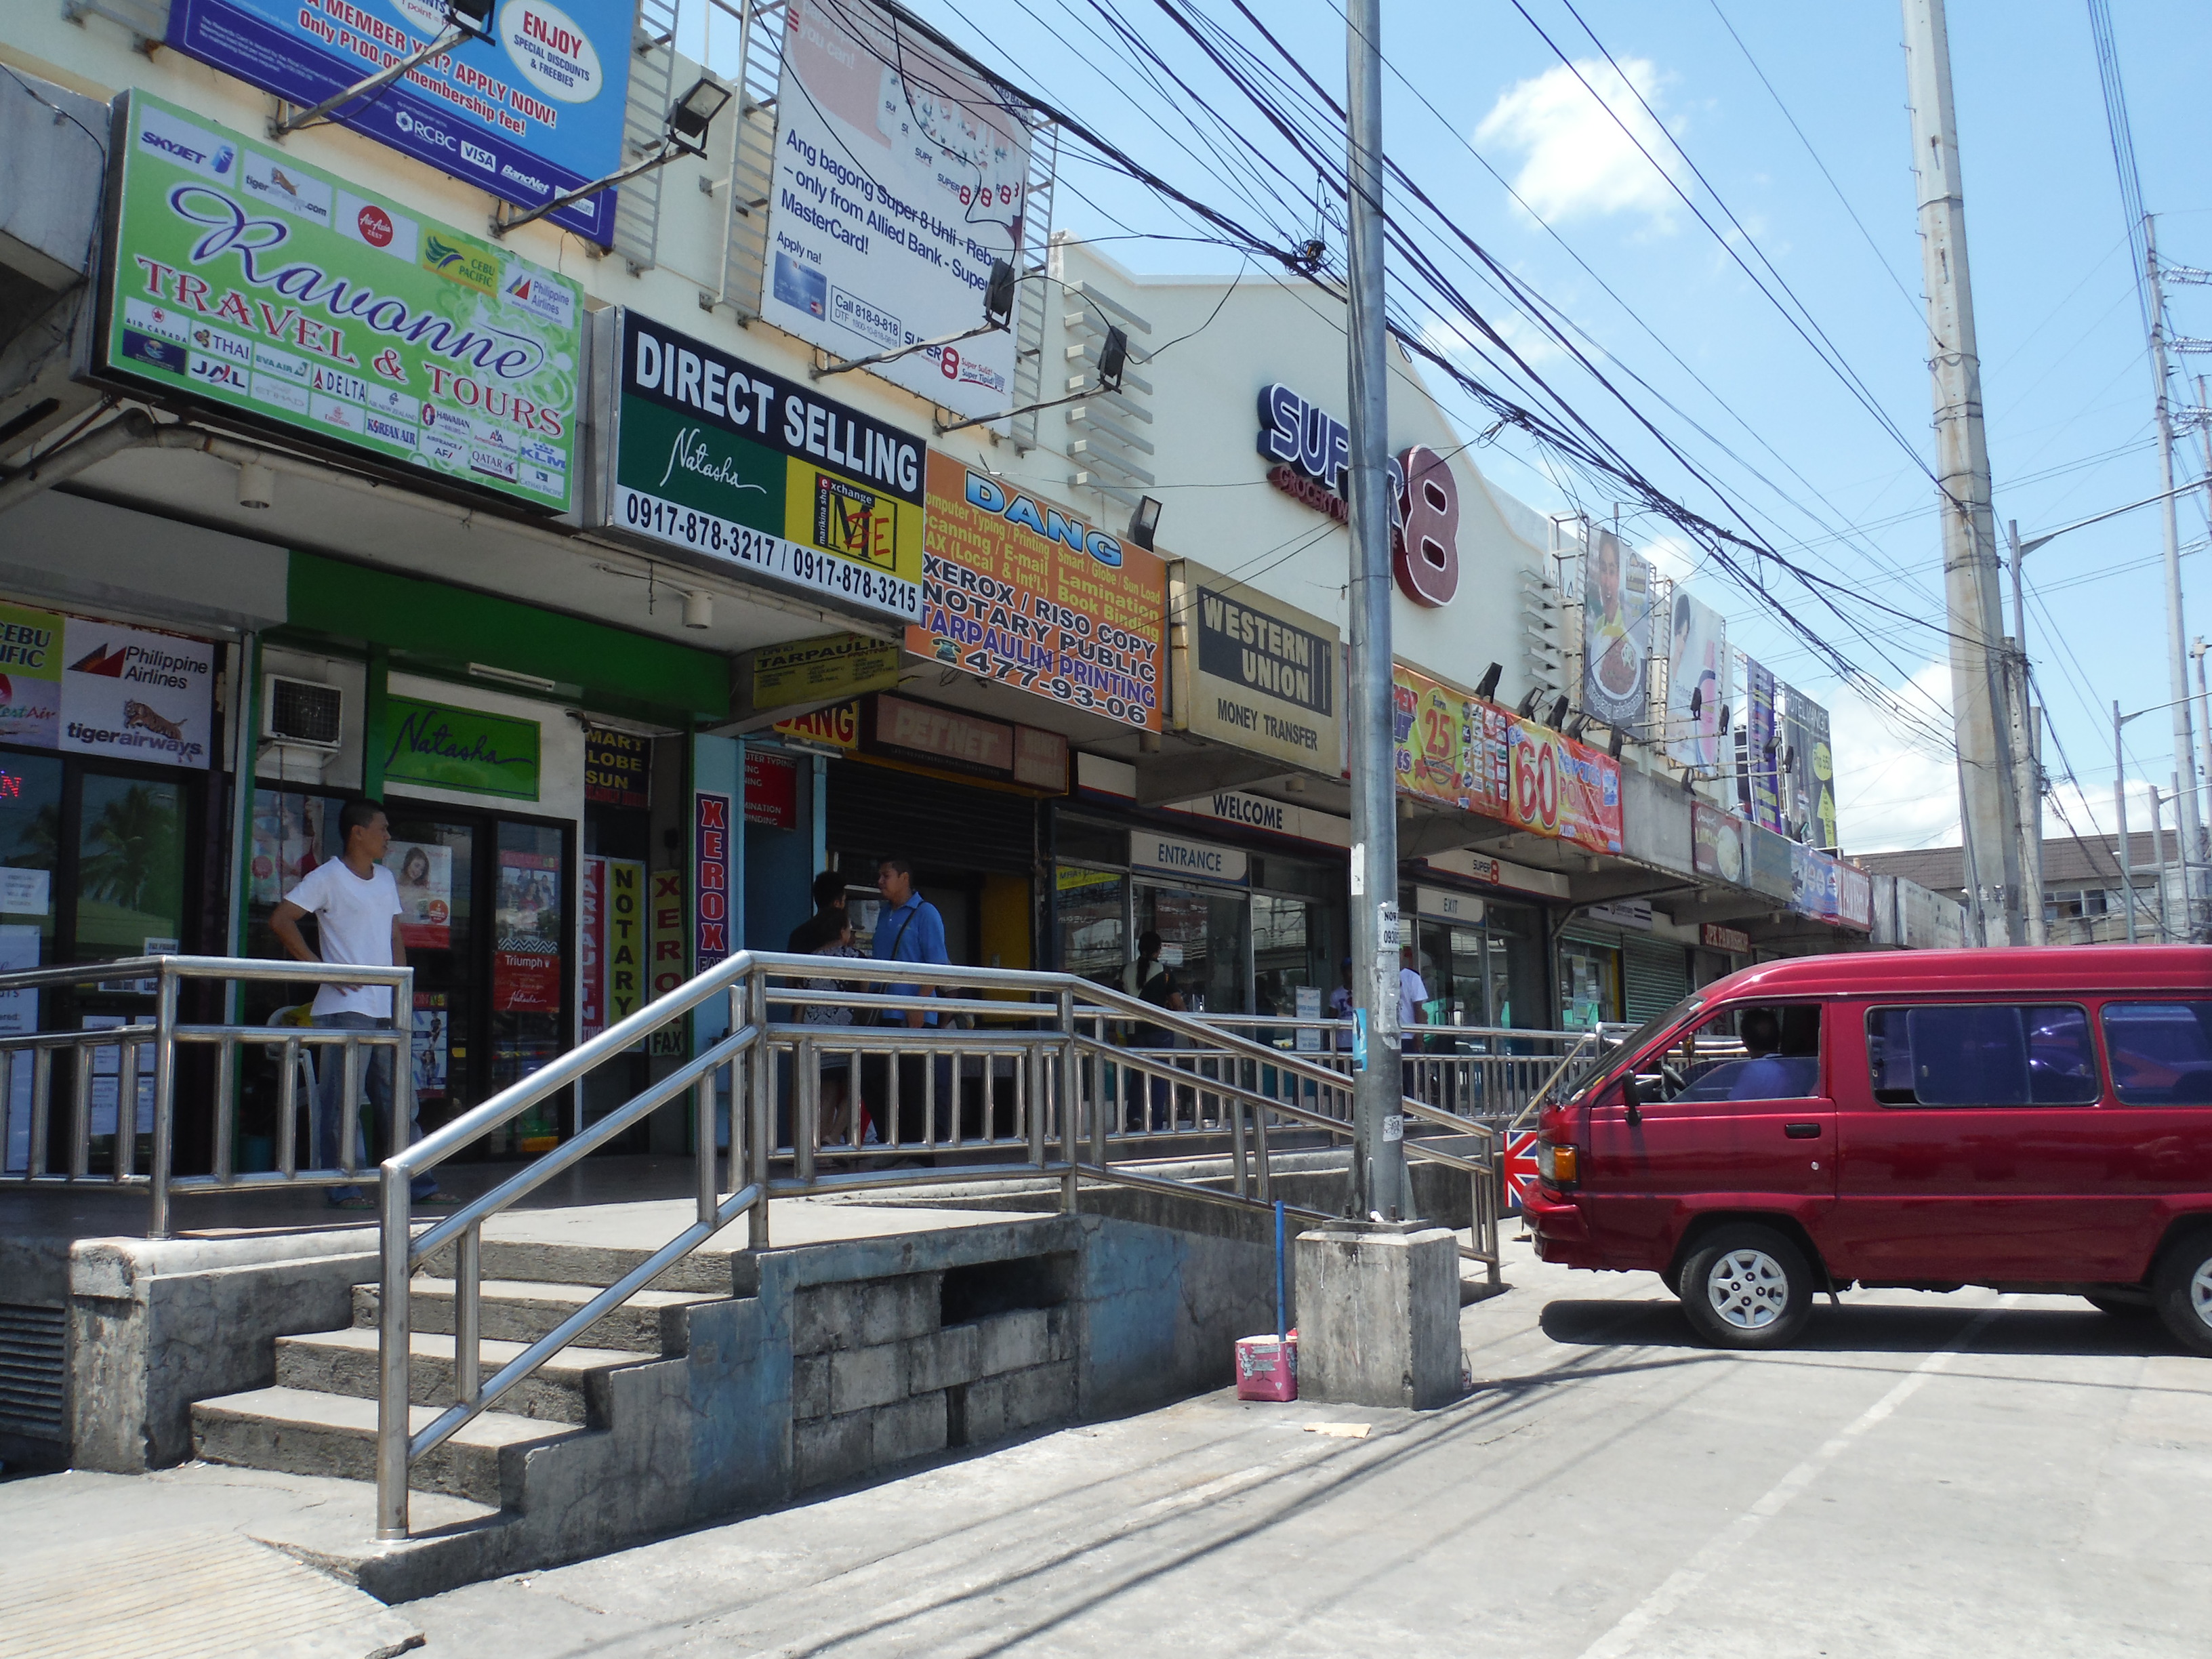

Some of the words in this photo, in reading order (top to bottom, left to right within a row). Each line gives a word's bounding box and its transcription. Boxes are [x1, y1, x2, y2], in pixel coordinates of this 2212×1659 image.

[408, 3, 432, 20] point
[523, 11, 582, 60] ENJOY
[300, 9, 335, 43] Only
[407, 68, 495, 122] membership
[499, 110, 526, 136] fee!
[325, 0, 405, 52] MEMBER
[411, 38, 451, 73] YT?
[455, 64, 507, 101] APPLY
[511, 91, 558, 127] NOW!
[514, 35, 545, 59] SPECIAL
[548, 50, 590, 81] DISCOUNTS
[531, 58, 537, 70] &
[539, 62, 574, 88] FREEBIES
[142, 131, 207, 164] SKYJET
[415, 122, 457, 152] RCBC
[464, 145, 494, 169] VISA
[504, 165, 550, 193] BancNet
[787, 129, 817, 167] Ang
[820, 148, 874, 201] bagong
[878, 184, 918, 222] Super
[920, 211, 929, 230] 8
[933, 215, 956, 247] Unli
[937, 173, 960, 193] SUPER
[959, 184, 971, 205] 8
[781, 188, 869, 255] MasterCard!
[796, 169, 827, 198] only
[830, 184, 864, 222] from
[867, 209, 905, 246] Allied
[908, 232, 942, 268] Bank
[777, 230, 805, 258] Apply
[806, 248, 822, 264] na!
[170, 186, 545, 380] Ravonne
[459, 265, 493, 287] PACIFIC
[471, 258, 495, 276] CEBU
[531, 295, 560, 315] Airlines
[533, 280, 570, 306] Philippine
[126, 317, 144, 328] AIR
[148, 324, 188, 344] CANADA
[836, 294, 853, 313] Call
[856, 304, 899, 337] 818-9-818
[138, 257, 356, 364] TRAVEL
[373, 350, 405, 381] &
[424, 363, 561, 436] TOURS
[213, 334, 250, 361] THAI
[941, 346, 960, 380] 8
[961, 357, 977, 369] Super
[327, 373, 365, 402] DELTA
[962, 368, 977, 380] Super
[436, 409, 471, 429] HAWAIIAN
[636, 331, 775, 434] DIRECT
[783, 394, 918, 493] SELLING
[367, 417, 398, 441] KOREAN
[399, 428, 415, 445] AIR
[472, 450, 503, 469] QATAR
[520, 447, 566, 469] KLM
[659, 427, 767, 495] Natasha
[819, 476, 873, 506] exchange
[926, 491, 970, 523] omputer
[972, 505, 1005, 541] Typing
[1014, 527, 1050, 560] Printing
[964, 469, 1123, 569] DANG
[1397, 443, 1460, 608] 8
[626, 492, 775, 568] 0917-878-3217
[793, 547, 917, 613] 0917-878-3215
[926, 530, 946, 554] AX
[950, 540, 994, 573] (Local
[1002, 562, 1012, 579] &
[1004, 544, 1049, 577] E-mail
[1058, 546, 1085, 574] Smart
[1092, 564, 1117, 586] Globe
[1124, 576, 1139, 593] Sun
[1141, 583, 1161, 605] Load
[1058, 567, 1160, 621] Lamination
[924, 553, 1016, 608] XEROX
[1035, 596, 1091, 636] RISO
[1097, 624, 1156, 661] COPY
[1057, 583, 1099, 616] Book
[1103, 599, 1160, 642] Binding
[923, 577, 1051, 644] NOTARY
[1059, 631, 1155, 684] PUBLIC
[1202, 592, 1309, 668] WESTERN
[0, 645, 45, 668] IFIC
[125, 645, 209, 676] Philippine
[919, 605, 1054, 673] TARPAULIN
[1059, 655, 1155, 708] PRINTING
[1242, 647, 1309, 703] UNION
[125, 665, 188, 689] Airlines
[964, 651, 1147, 726] 477-93-06
[67, 721, 203, 756] tigerairways
[384, 710, 535, 769] Natasha
[586, 730, 644, 752] MART
[1217, 697, 1258, 732] MONEY
[1263, 714, 1319, 752] TRANSFER
[1425, 708, 1451, 758] 25
[588, 749, 642, 772] LOBE
[745, 753, 764, 763] UTER
[766, 756, 796, 769] TYPING
[586, 770, 628, 790] SUN
[1515, 733, 1558, 830] 60
[1213, 793, 1283, 830] WELCOME
[700, 798, 725, 951] XEROX
[1158, 842, 1222, 873] ENTRANCE
[1473, 859, 1490, 874] SUPER
[1490, 859, 1499, 885] 8
[1443, 897, 1458, 915] EXIT
[615, 867, 634, 1017] NOTARY
[654, 875, 682, 1023] XERO
[505, 954, 543, 970] Triumph
[653, 1030, 682, 1053] FAX
